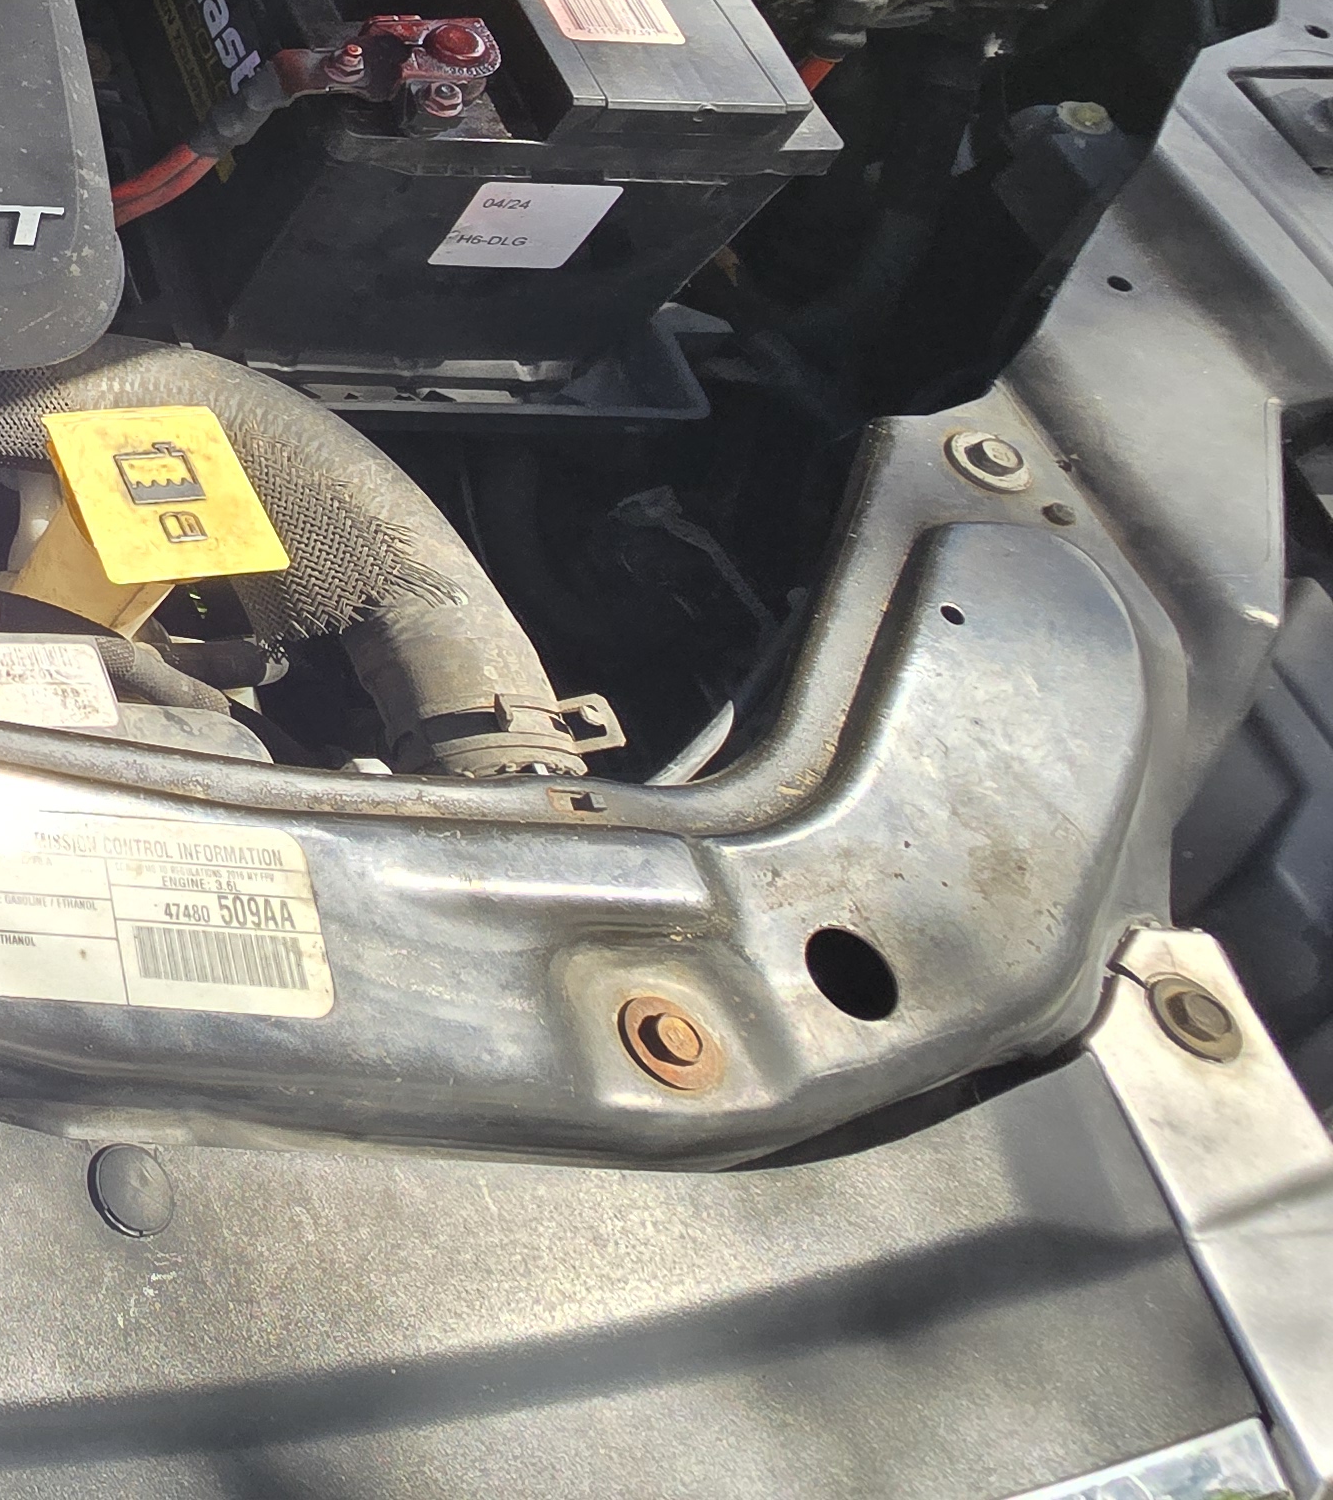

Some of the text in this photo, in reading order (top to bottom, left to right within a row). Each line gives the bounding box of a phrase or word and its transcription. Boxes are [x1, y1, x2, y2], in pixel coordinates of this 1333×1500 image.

[482, 198, 532, 210] 04/24
[456, 234, 528, 247] H6-DLG
[102, 836, 173, 859] CONTROL
[177, 842, 284, 868] INFORMATION
[161, 876, 242, 893] ENGINE: 3.6L
[4, 894, 47, 908] GASOLINE
[56, 898, 98, 911] ETHANOL
[163, 893, 297, 931] 47480 509AA
